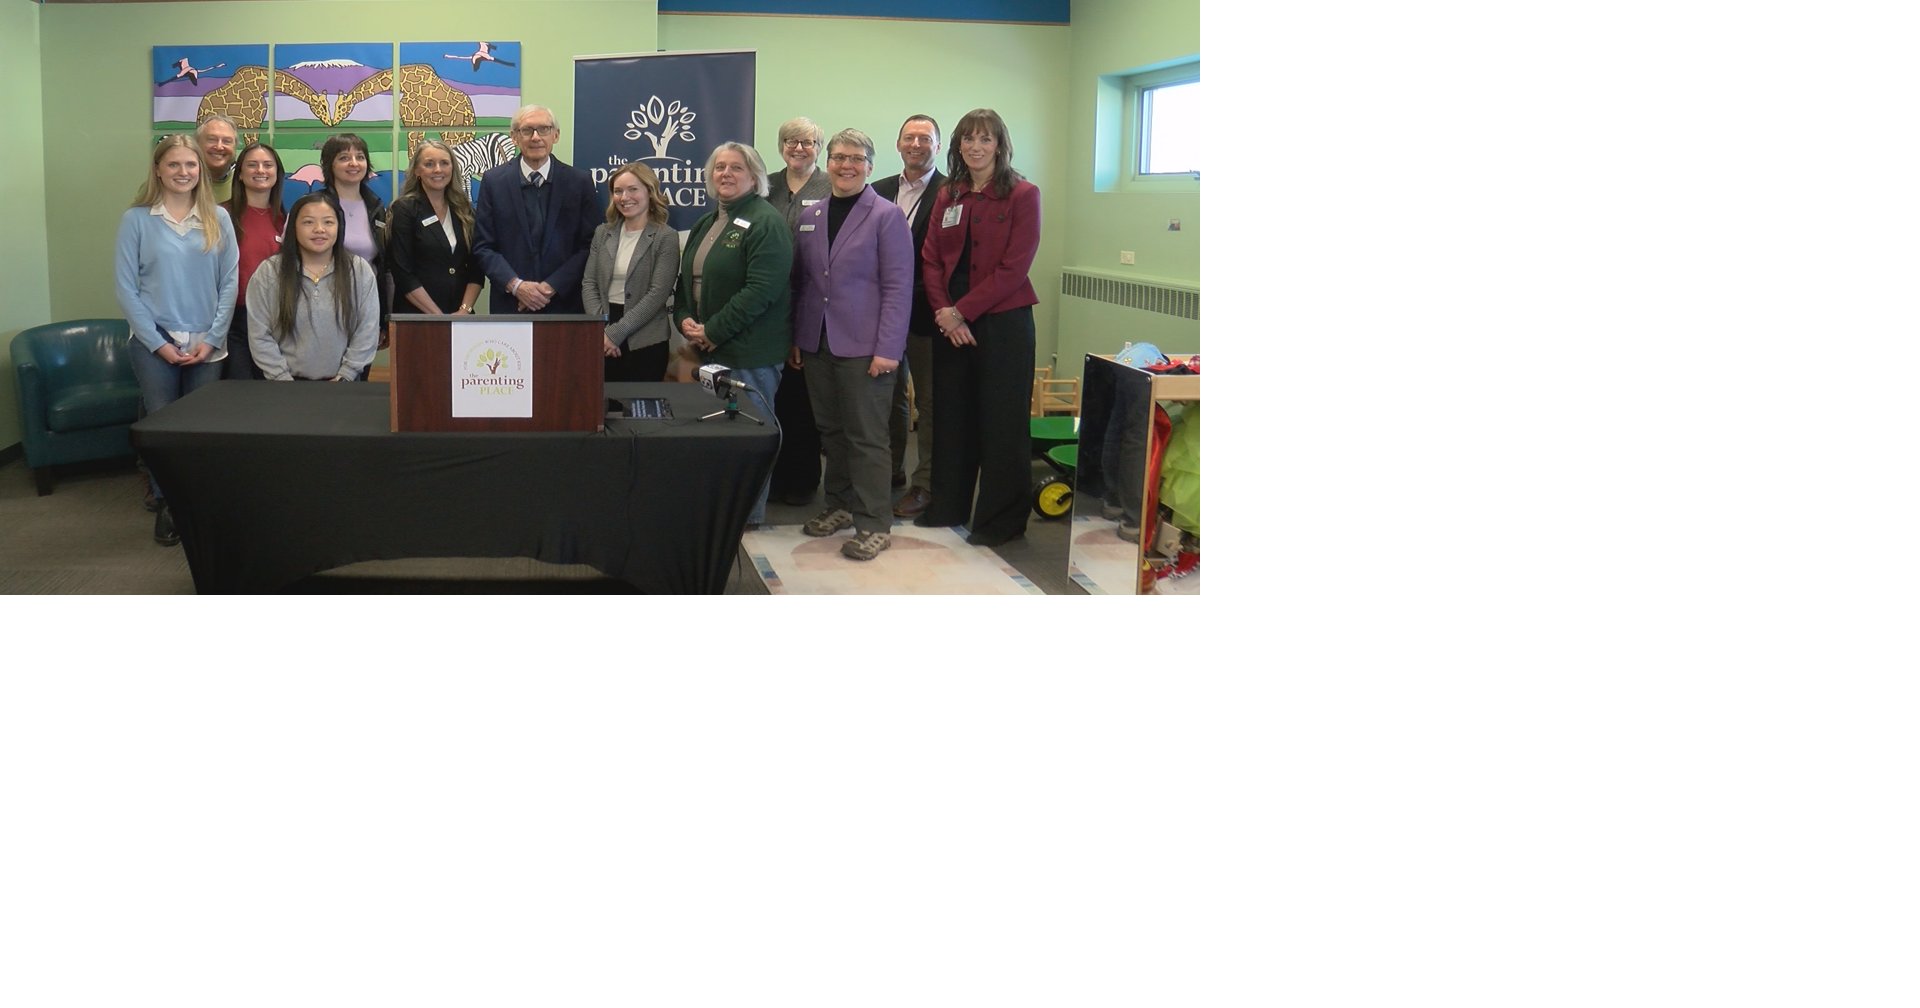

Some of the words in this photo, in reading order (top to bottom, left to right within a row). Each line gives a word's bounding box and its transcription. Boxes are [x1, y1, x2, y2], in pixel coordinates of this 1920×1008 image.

[608, 154, 629, 166] the
[590, 159, 708, 193] pntin
[662, 187, 706, 207] ACE
[461, 375, 525, 389] parenting
[480, 387, 514, 395] PLACE
